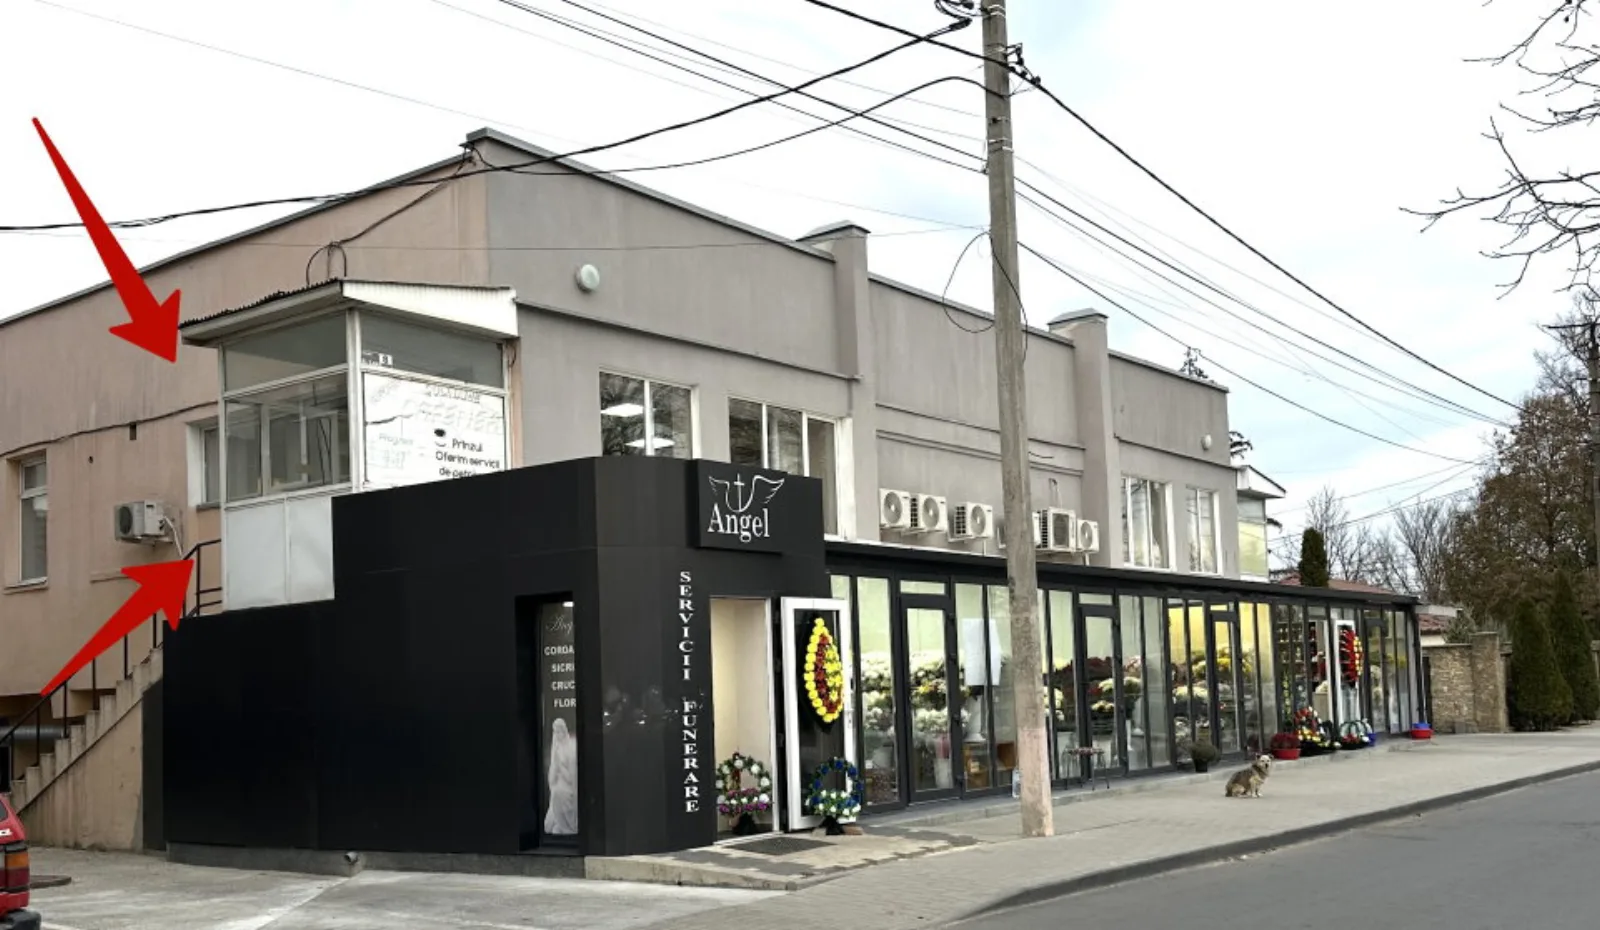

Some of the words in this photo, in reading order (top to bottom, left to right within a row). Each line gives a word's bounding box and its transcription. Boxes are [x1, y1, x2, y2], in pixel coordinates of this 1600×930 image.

[707, 503, 770, 543] Angel
[679, 571, 695, 681] SERVICII
[682, 700, 700, 813] FUNERARE
